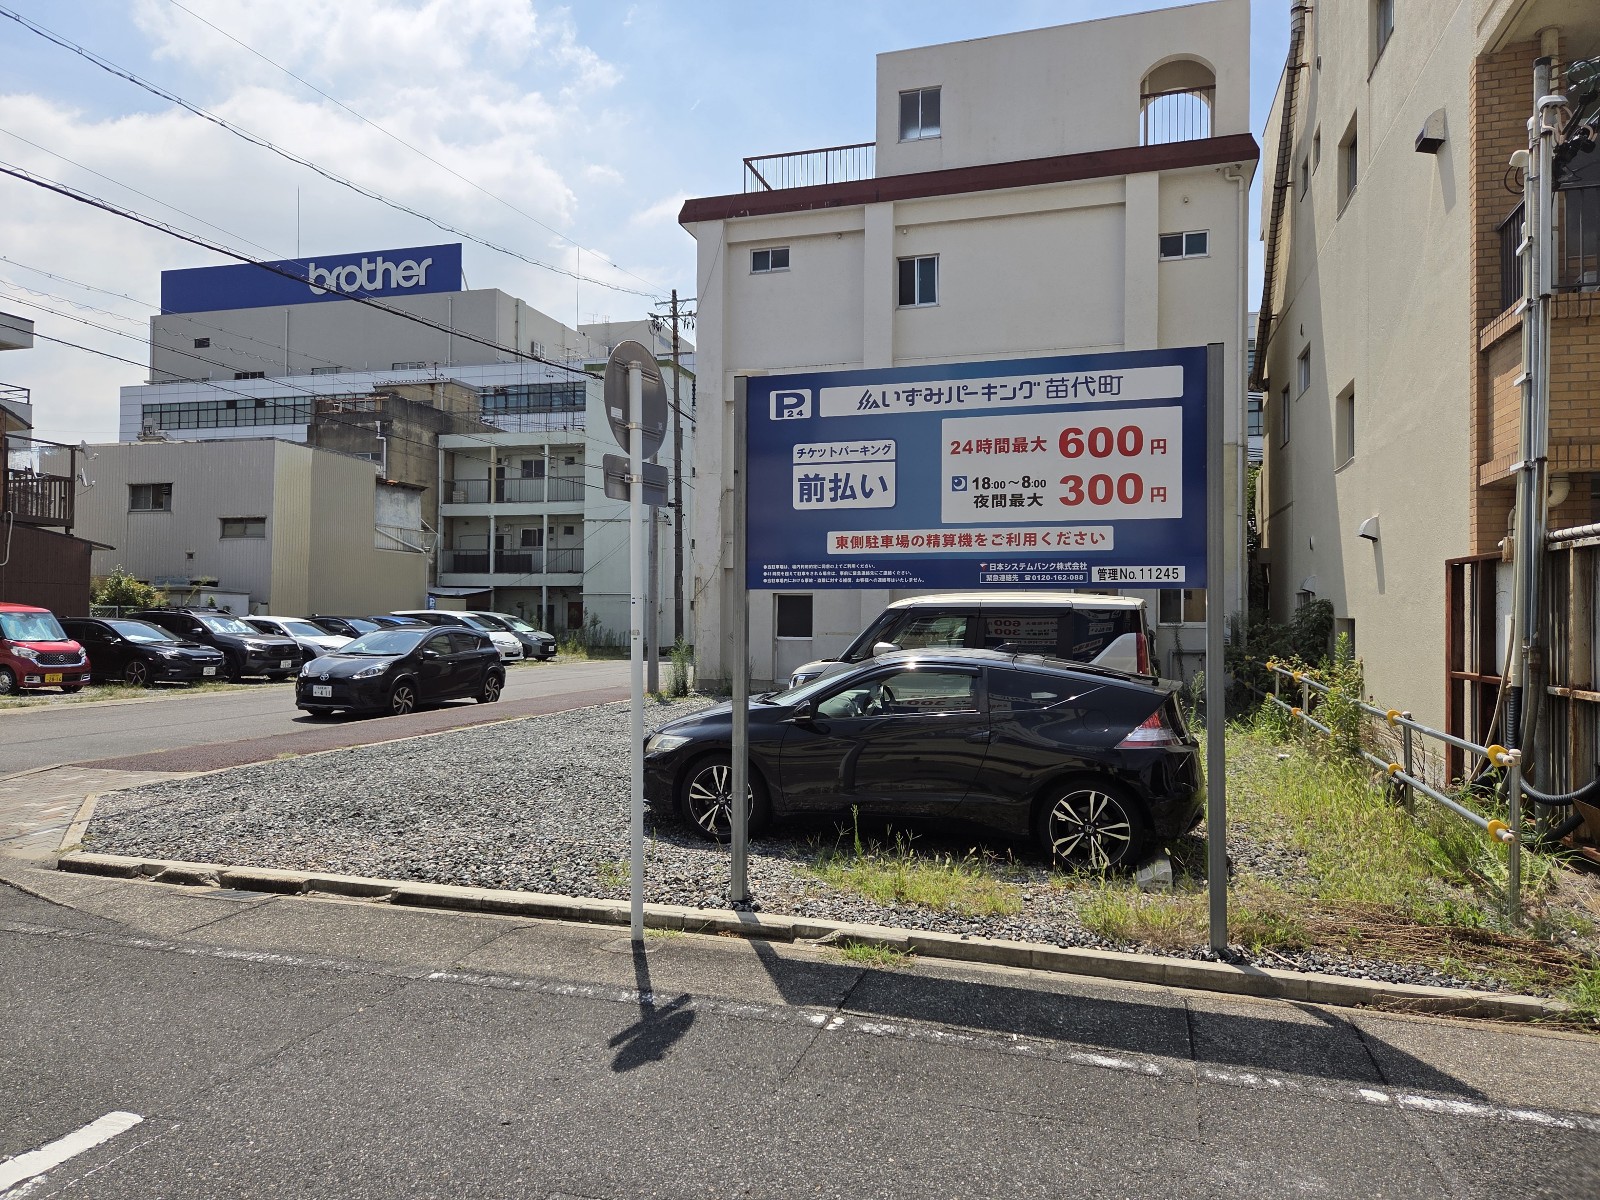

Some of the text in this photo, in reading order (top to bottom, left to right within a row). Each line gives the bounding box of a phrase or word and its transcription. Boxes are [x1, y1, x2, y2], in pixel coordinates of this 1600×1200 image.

[309, 256, 432, 295] brother
[787, 409, 804, 418] 24
[796, 443, 892, 459] チケットパーキング
[950, 435, 1048, 455] 24時間最大
[797, 472, 889, 503] 前払い
[973, 492, 1044, 509] 夜間最大
[835, 531, 1106, 550] 東側駐車場の精算機をご利用ください
[989, 561, 1088, 571] 日本システムバンク株式会社
[986, 574, 1019, 582] 緊急連絡先
